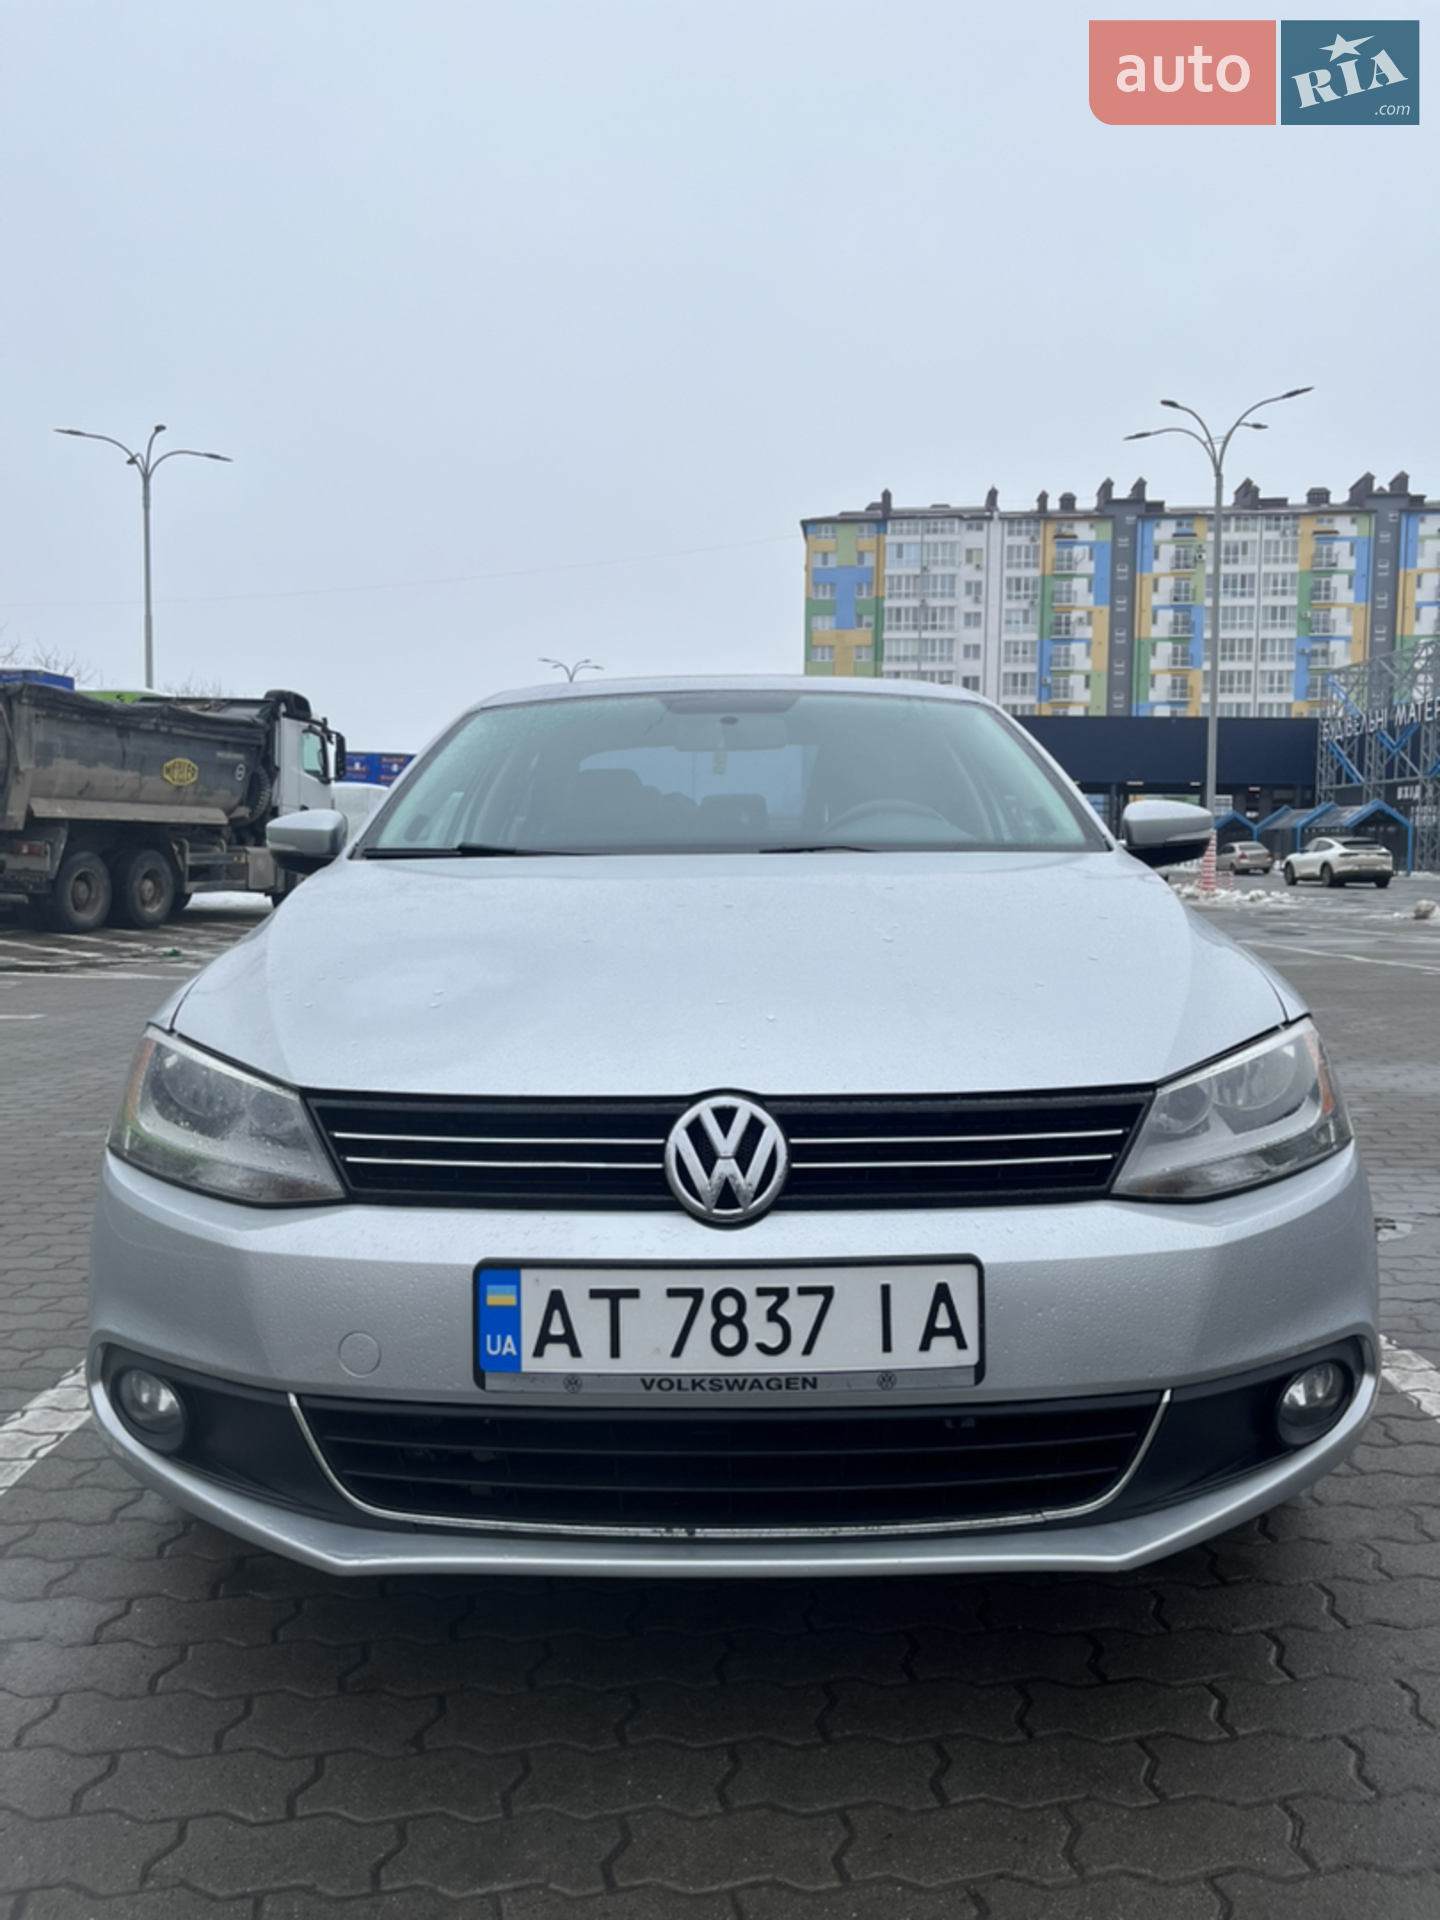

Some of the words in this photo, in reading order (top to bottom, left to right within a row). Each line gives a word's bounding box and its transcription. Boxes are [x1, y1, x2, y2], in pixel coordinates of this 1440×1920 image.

[532, 1288, 641, 1359] AT
[666, 1285, 835, 1358] 7837
[881, 1282, 969, 1354] IA
[486, 1334, 517, 1356] UA
[640, 1376, 819, 1393] VOLKSWAGEN
